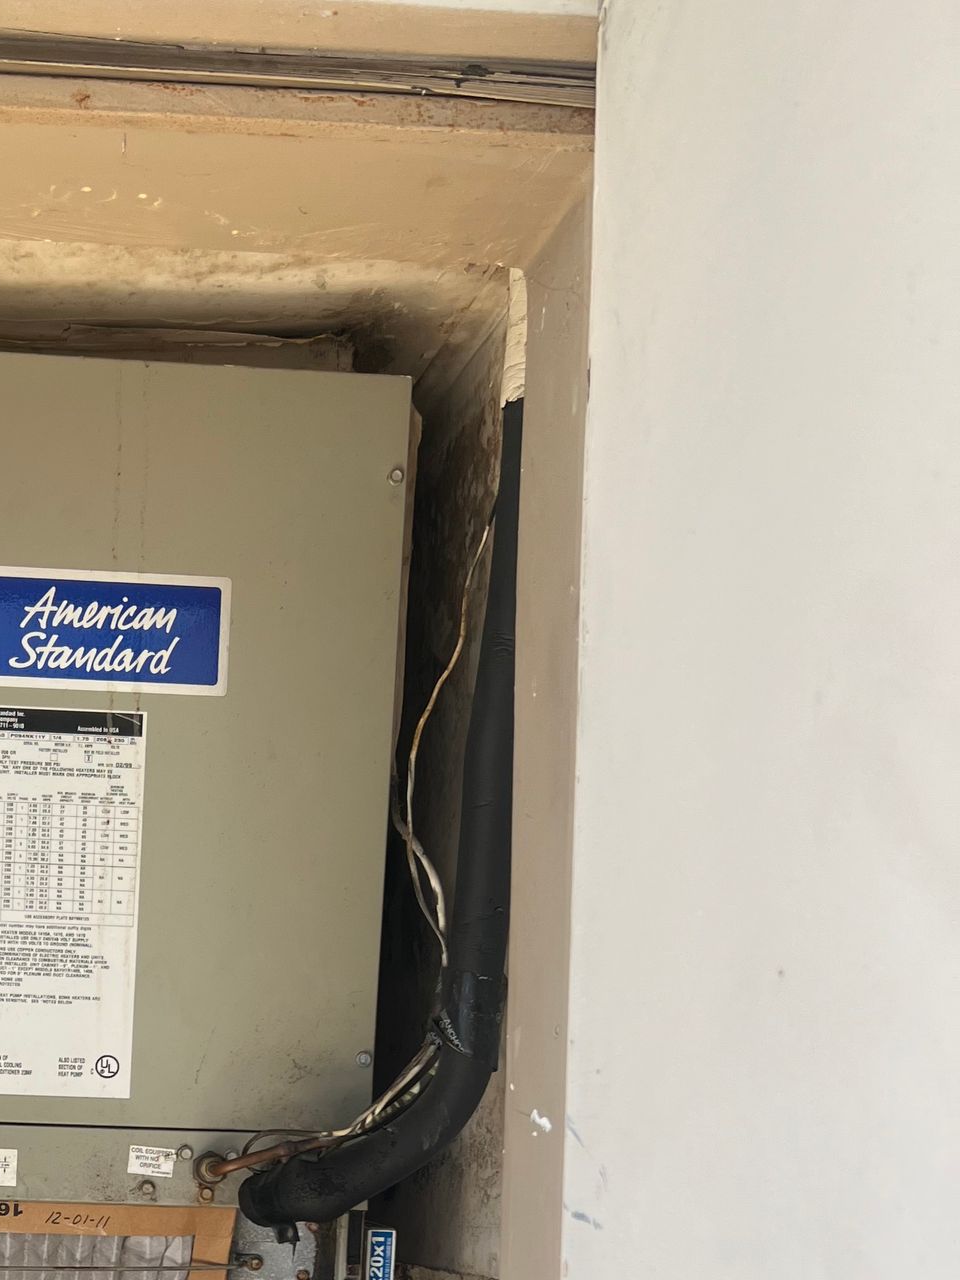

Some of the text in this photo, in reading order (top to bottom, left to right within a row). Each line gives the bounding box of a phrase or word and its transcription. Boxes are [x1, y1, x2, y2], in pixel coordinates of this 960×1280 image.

[20, 586, 177, 633] American
[9, 631, 180, 675] Standard
[101, 1059, 116, 1074] UL
[45, 1211, 111, 1229] 12-01-11
